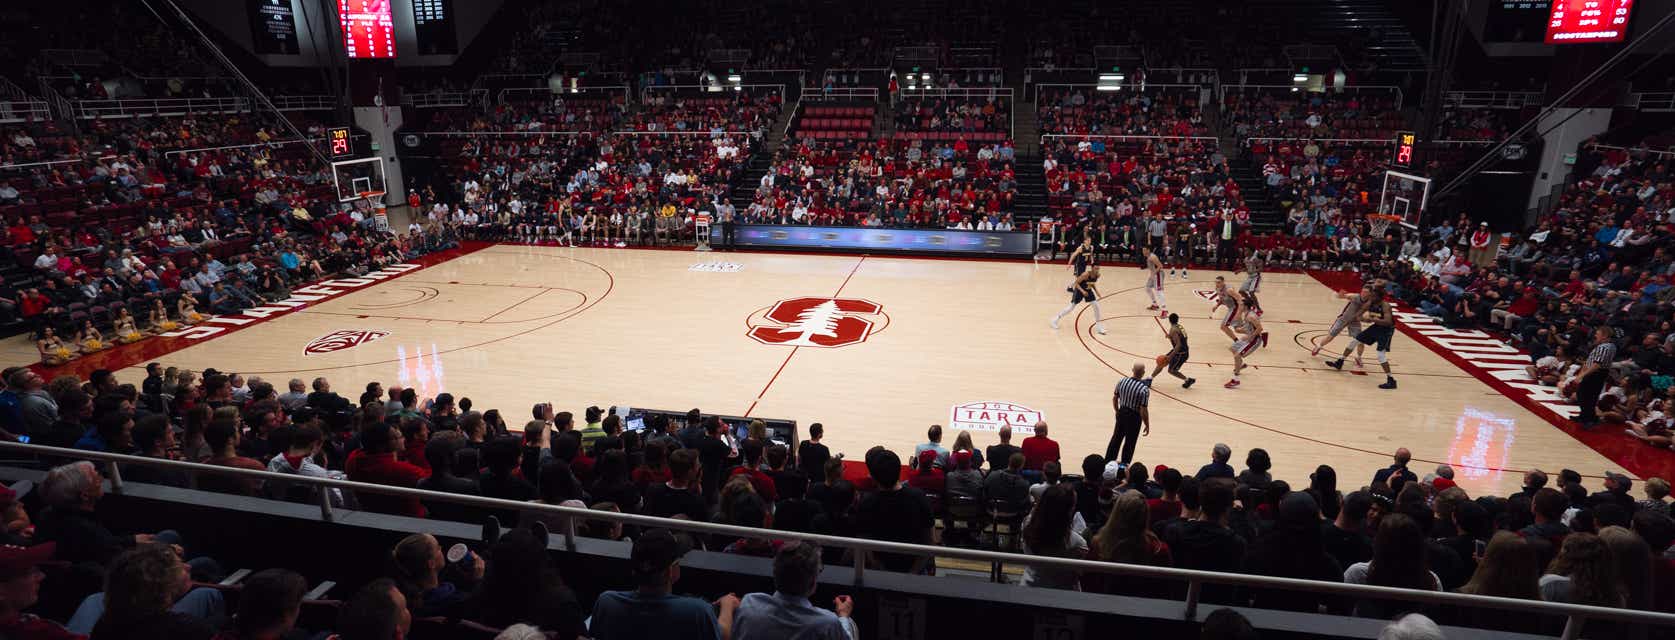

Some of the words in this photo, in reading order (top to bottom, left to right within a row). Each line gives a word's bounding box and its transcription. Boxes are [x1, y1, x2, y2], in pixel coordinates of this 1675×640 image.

[333, 130, 347, 138] 7:07
[333, 139, 347, 153] 29
[1398, 145, 1411, 162] 29
[965, 410, 1027, 426] TARA
